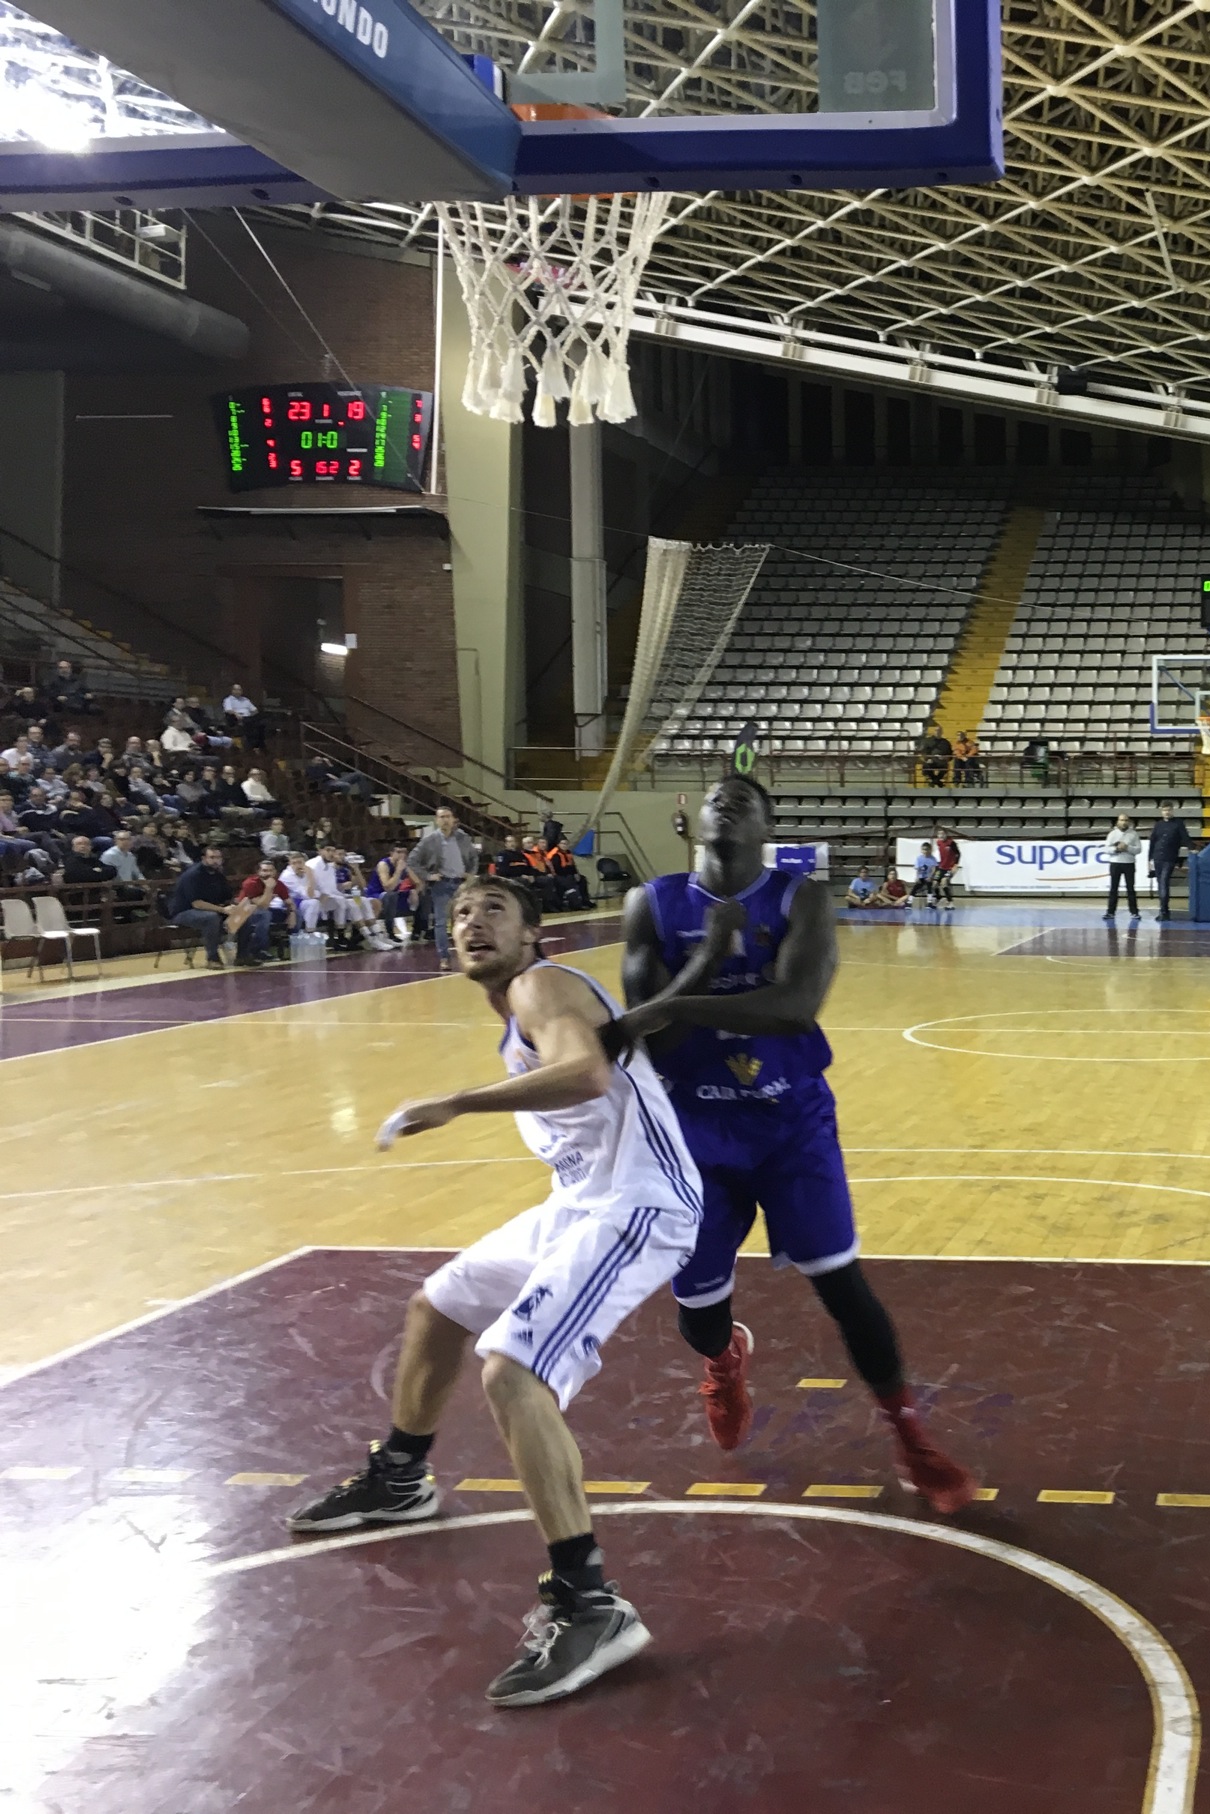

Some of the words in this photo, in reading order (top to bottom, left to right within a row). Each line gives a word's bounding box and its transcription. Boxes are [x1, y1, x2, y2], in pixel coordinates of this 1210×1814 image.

[288, 401, 311, 420] 23
[290, 459, 302, 476] 5
[348, 459, 361, 476] 2
